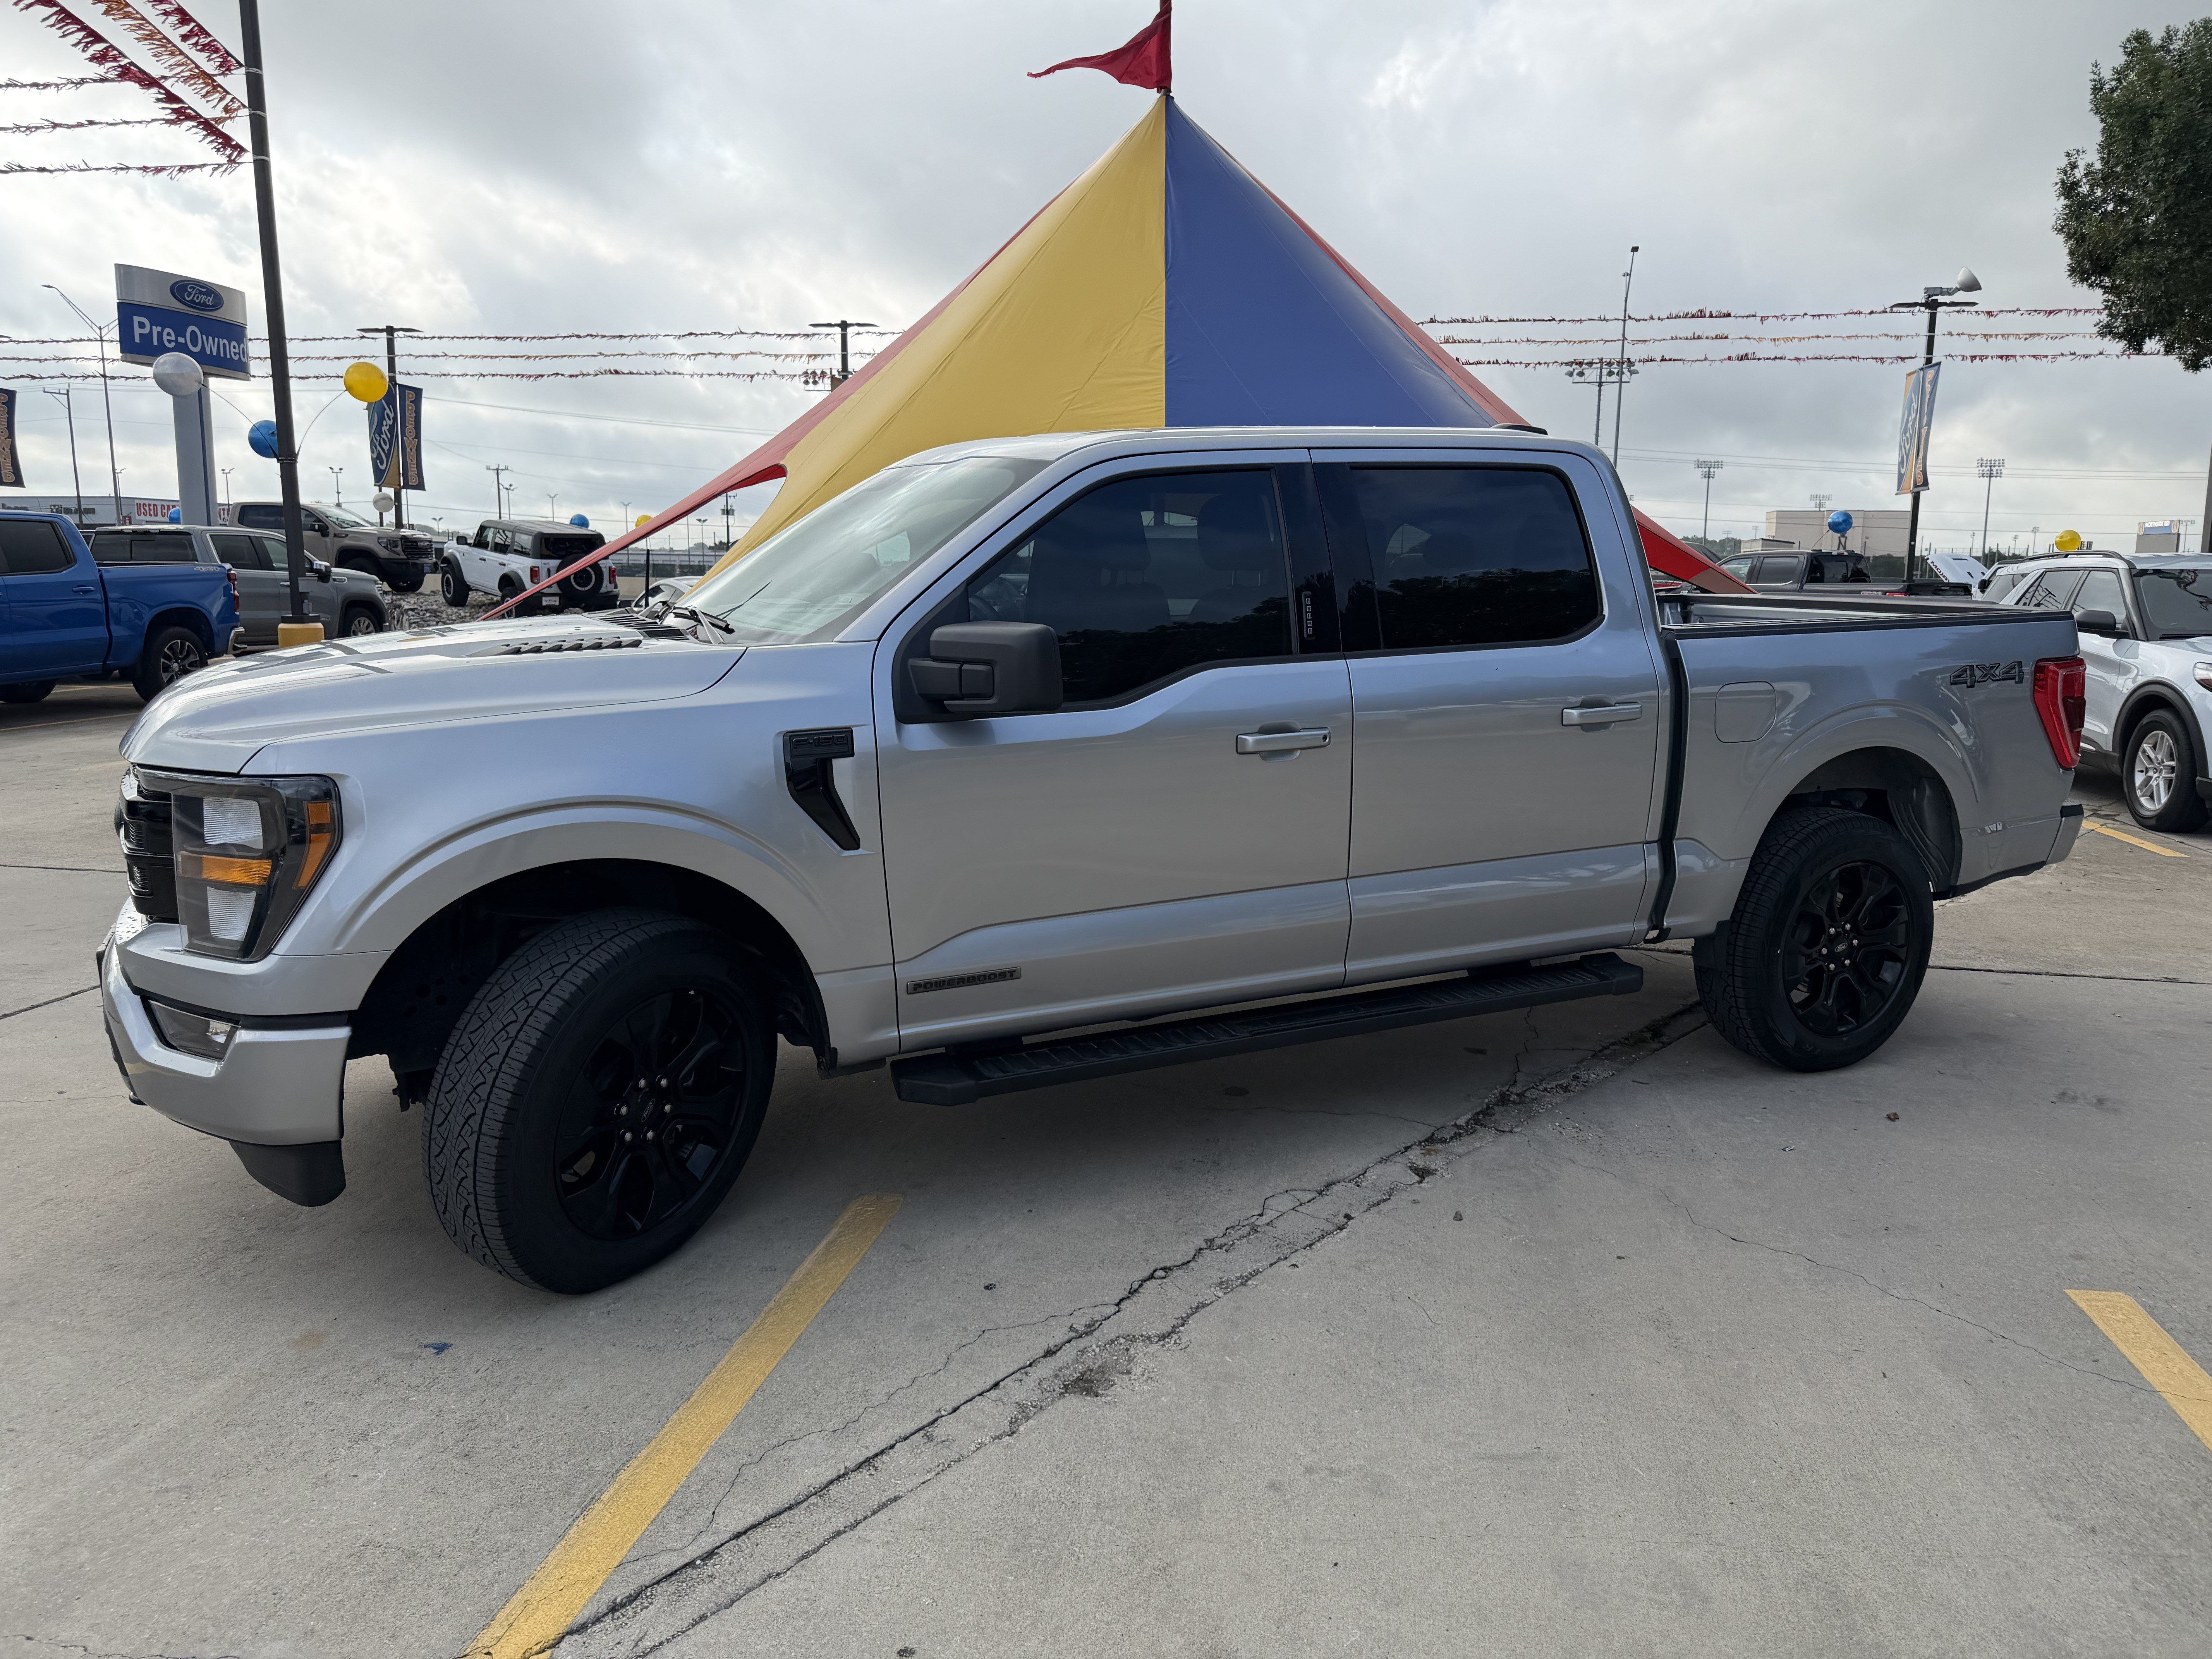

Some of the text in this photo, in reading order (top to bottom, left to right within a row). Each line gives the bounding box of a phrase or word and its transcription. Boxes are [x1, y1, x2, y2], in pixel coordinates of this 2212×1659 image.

[185, 285, 214, 305] Ford
[133, 316, 247, 362] Pre-Owned
[369, 398, 394, 470] Ford
[404, 390, 419, 485] PREOWNED
[1898, 392, 1917, 474] Ford
[136, 502, 176, 518] USED CA
[1930, 561, 1949, 582] MOJA
[792, 734, 848, 749] F-150
[913, 970, 1017, 991] POWERBOOST
